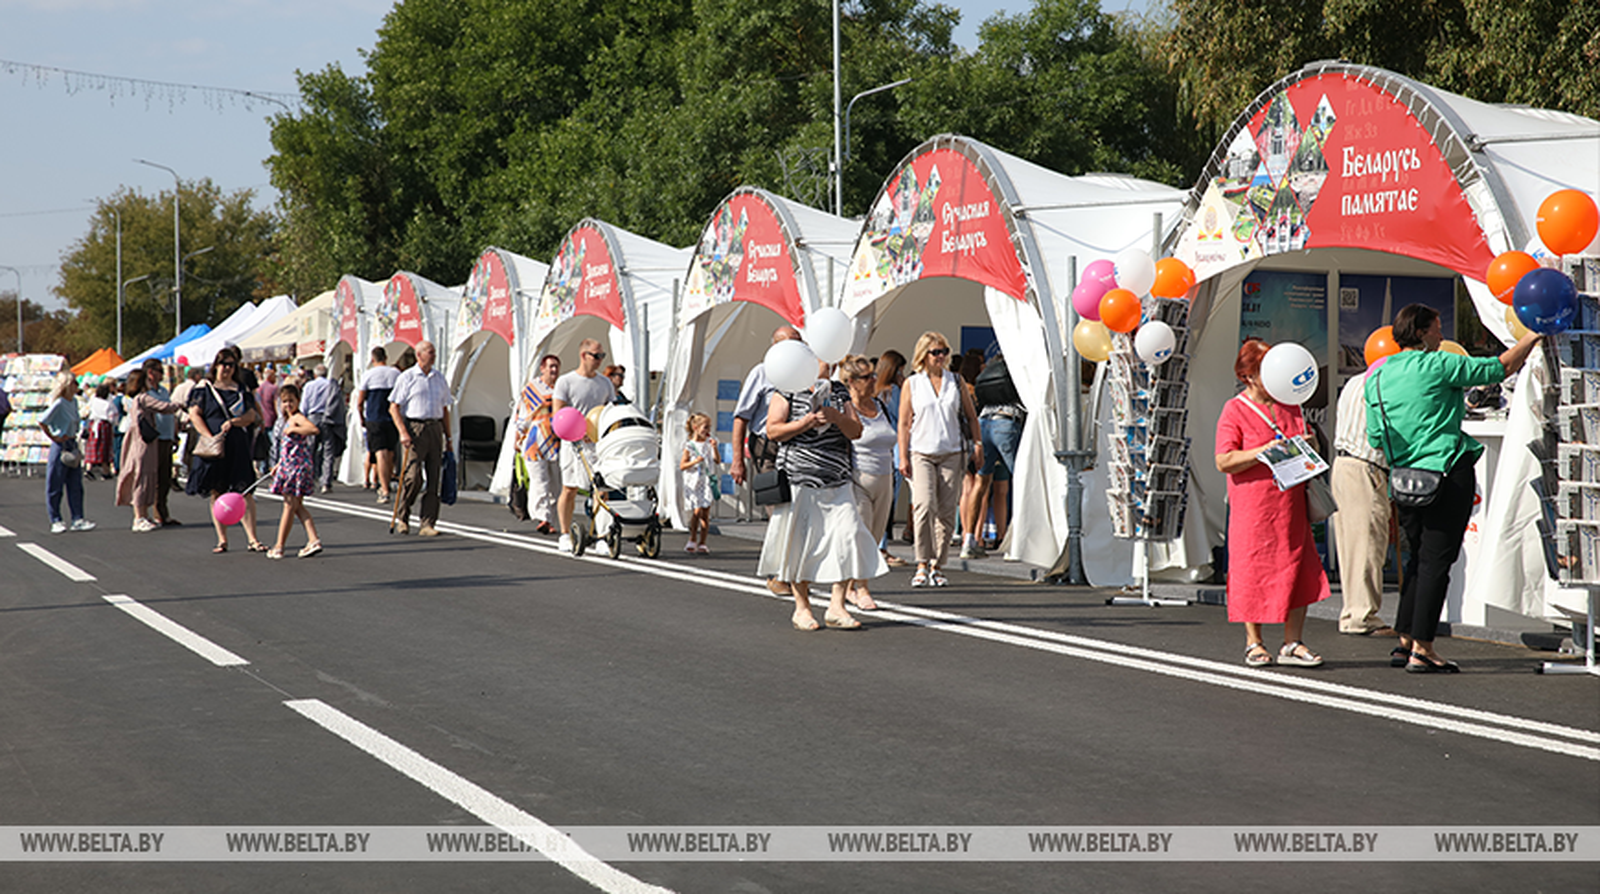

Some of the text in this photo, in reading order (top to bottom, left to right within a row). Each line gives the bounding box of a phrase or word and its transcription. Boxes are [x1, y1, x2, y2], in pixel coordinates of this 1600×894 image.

[1341, 146, 1421, 183] Беларусь
[942, 201, 990, 231] Сучасная
[1341, 187, 1419, 217] памятае
[941, 230, 988, 257] Беларусь
